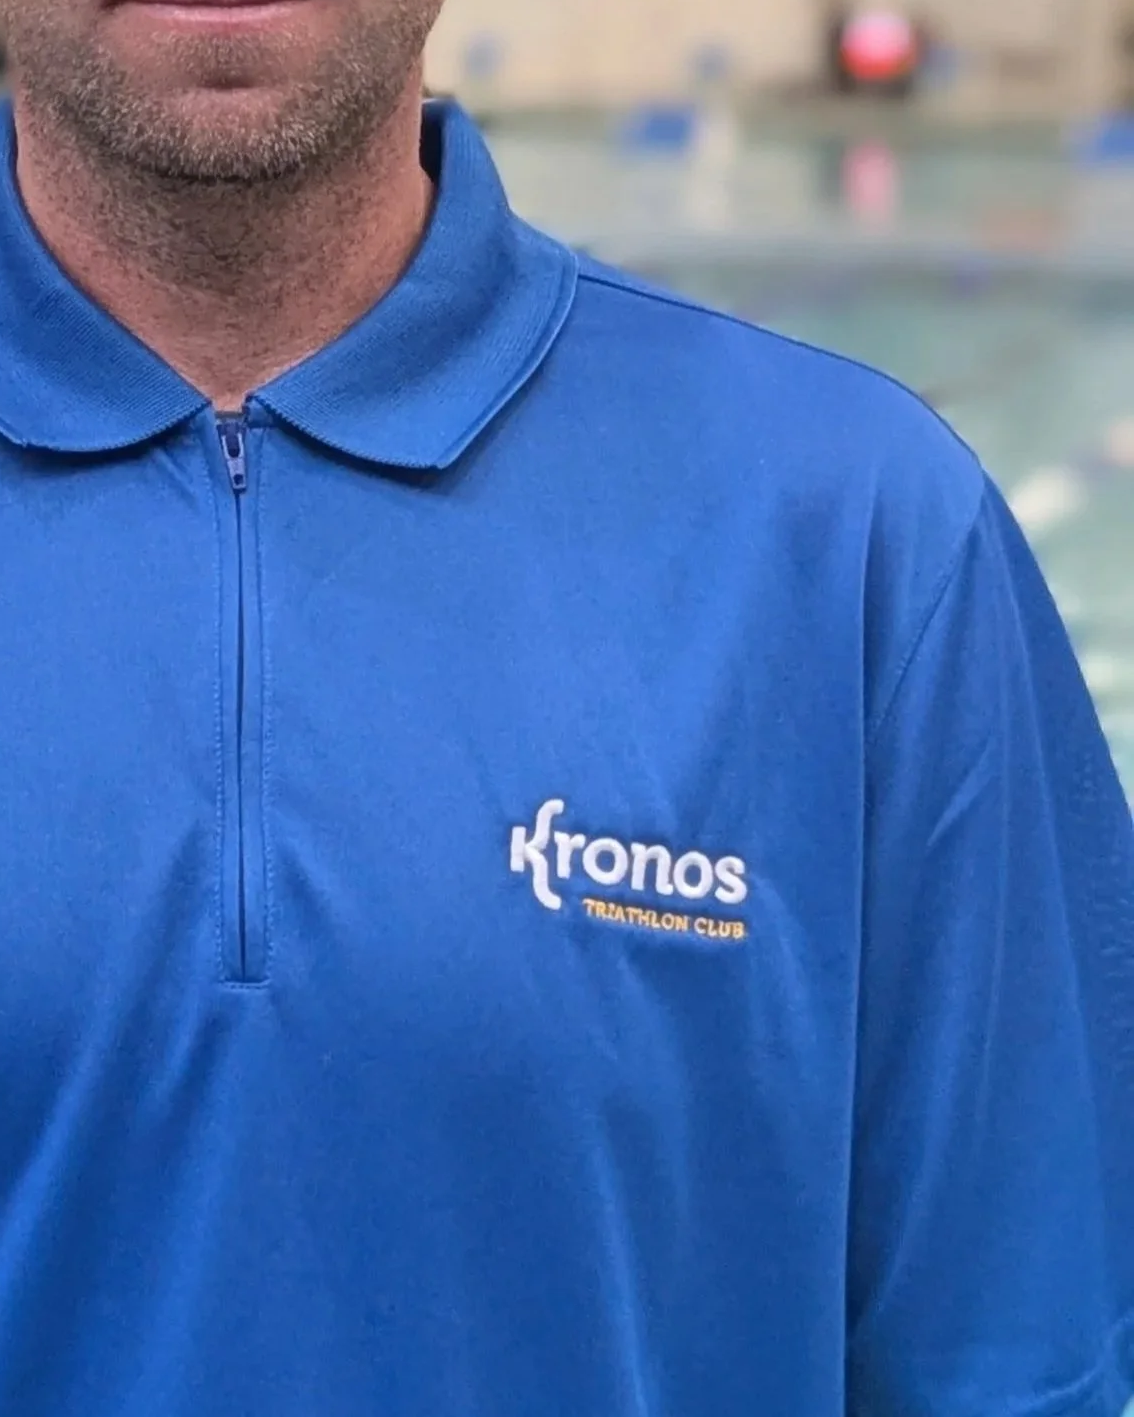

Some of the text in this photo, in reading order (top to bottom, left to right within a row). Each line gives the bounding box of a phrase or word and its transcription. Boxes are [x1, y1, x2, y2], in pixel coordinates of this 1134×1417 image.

[510, 799, 748, 910] Kronos
[582, 898, 746, 939] TRIATHLON CLUB
